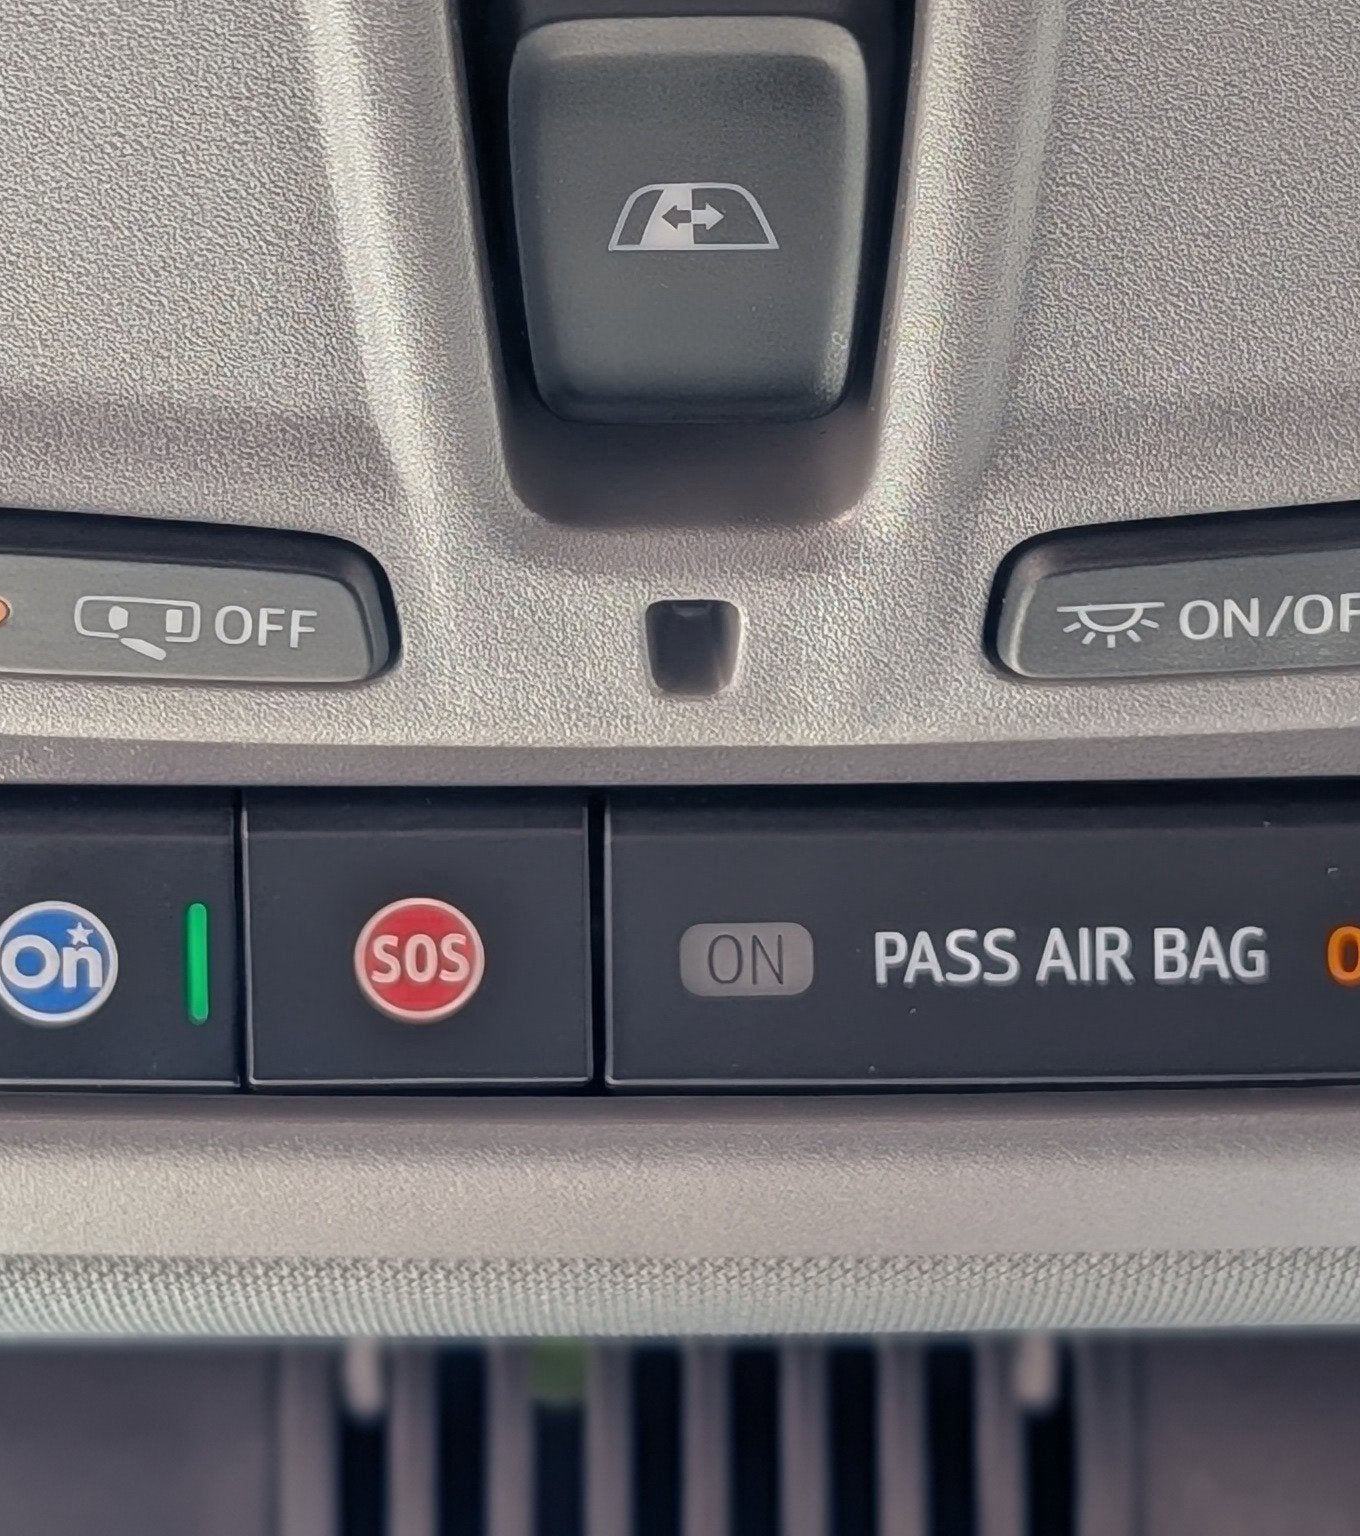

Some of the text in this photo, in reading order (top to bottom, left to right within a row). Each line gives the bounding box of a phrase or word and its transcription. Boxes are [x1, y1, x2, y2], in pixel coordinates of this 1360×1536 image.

[213, 604, 319, 649] OFF
[370, 932, 472, 984] SOS
[706, 933, 786, 986] ON
[874, 927, 1021, 986] PASS
[1035, 926, 1136, 985] AIR
[1152, 925, 1269, 985] BAG
